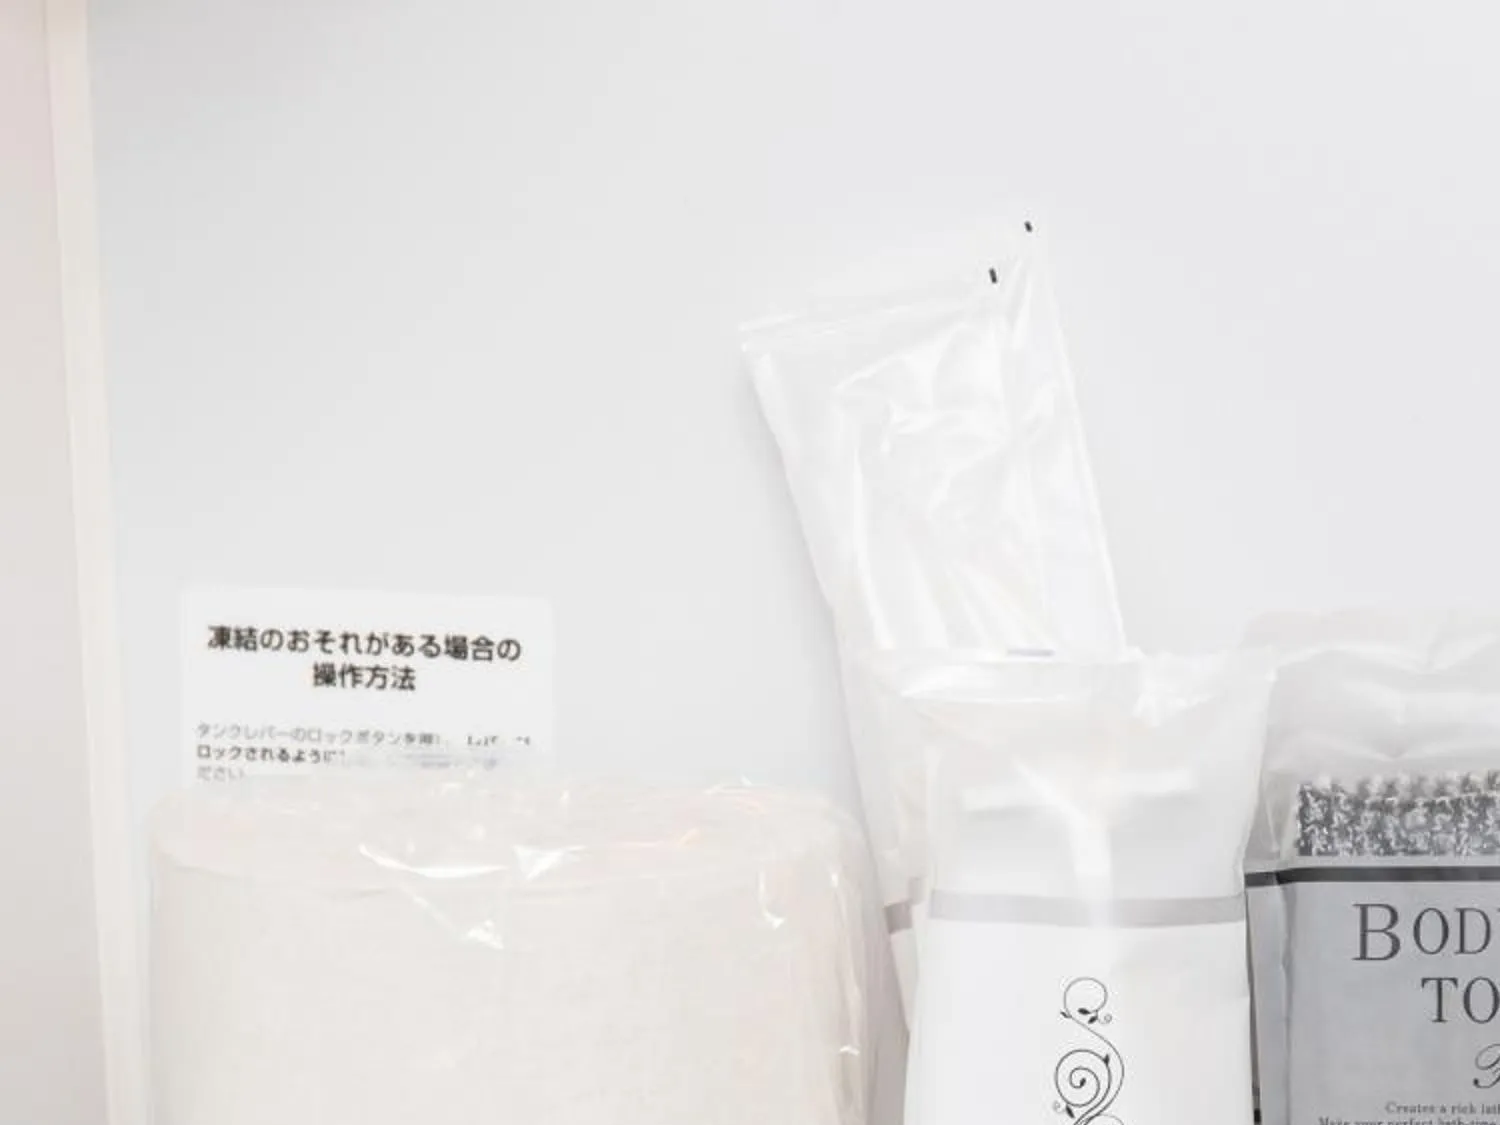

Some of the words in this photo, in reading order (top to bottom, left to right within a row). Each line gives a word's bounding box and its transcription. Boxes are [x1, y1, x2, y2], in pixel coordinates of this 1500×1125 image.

[207, 624, 522, 662] 凍結のおそれがある場合の
[312, 661, 417, 692] 操作方法
[1385, 1101, 1435, 1115] Creates
[1439, 1103, 1447, 1114] a
[1451, 1102, 1477, 1115] rich
